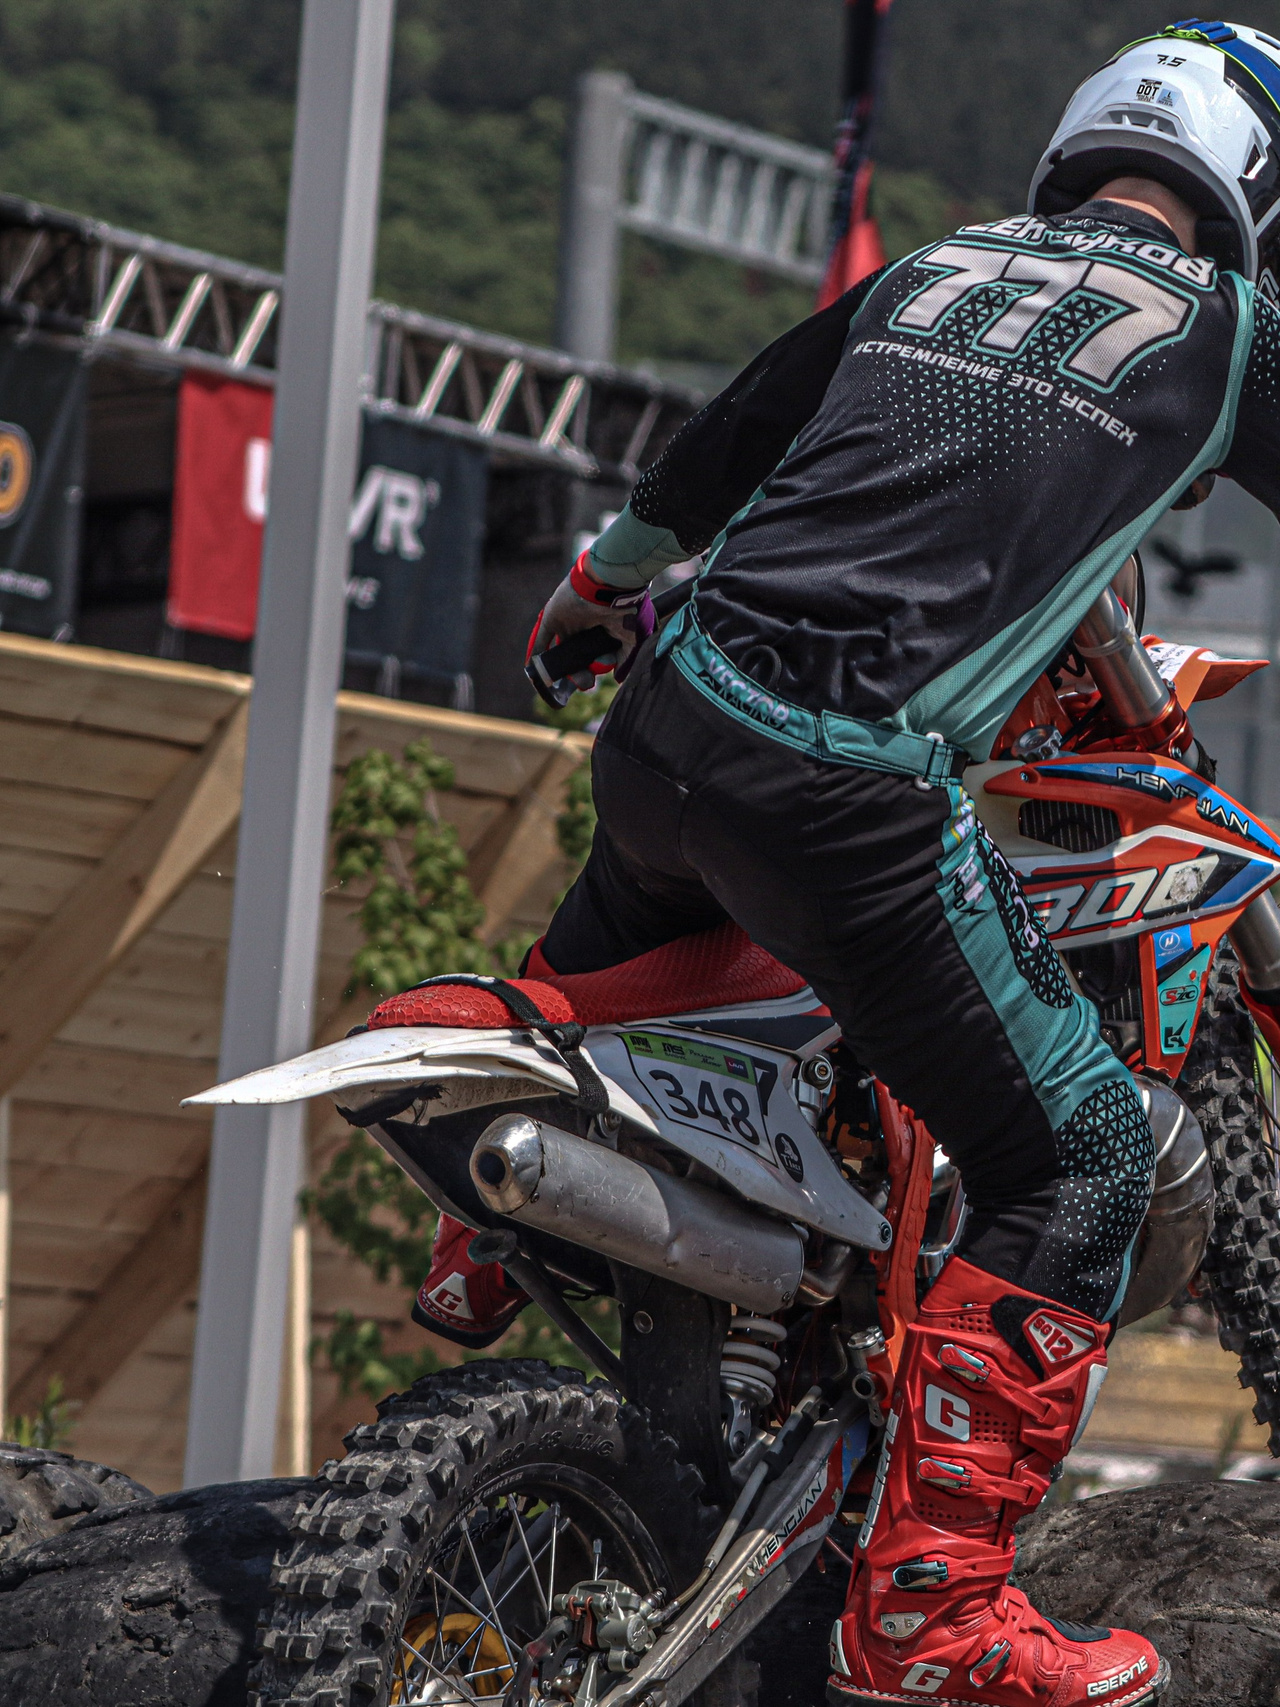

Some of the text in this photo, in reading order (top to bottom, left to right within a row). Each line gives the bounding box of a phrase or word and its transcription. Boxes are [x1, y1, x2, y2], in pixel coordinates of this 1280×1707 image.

[1156, 53, 1188, 68] 7.5
[1136, 84, 1160, 97] DOT
[893, 243, 1194, 386] 777
[851, 340, 1139, 448] #СТРЕМЛЕНИЕ ЭТО УСПЕХ
[648, 1069, 761, 1146] 348
[924, 1383, 971, 1442] G
[900, 1661, 951, 1694] G
